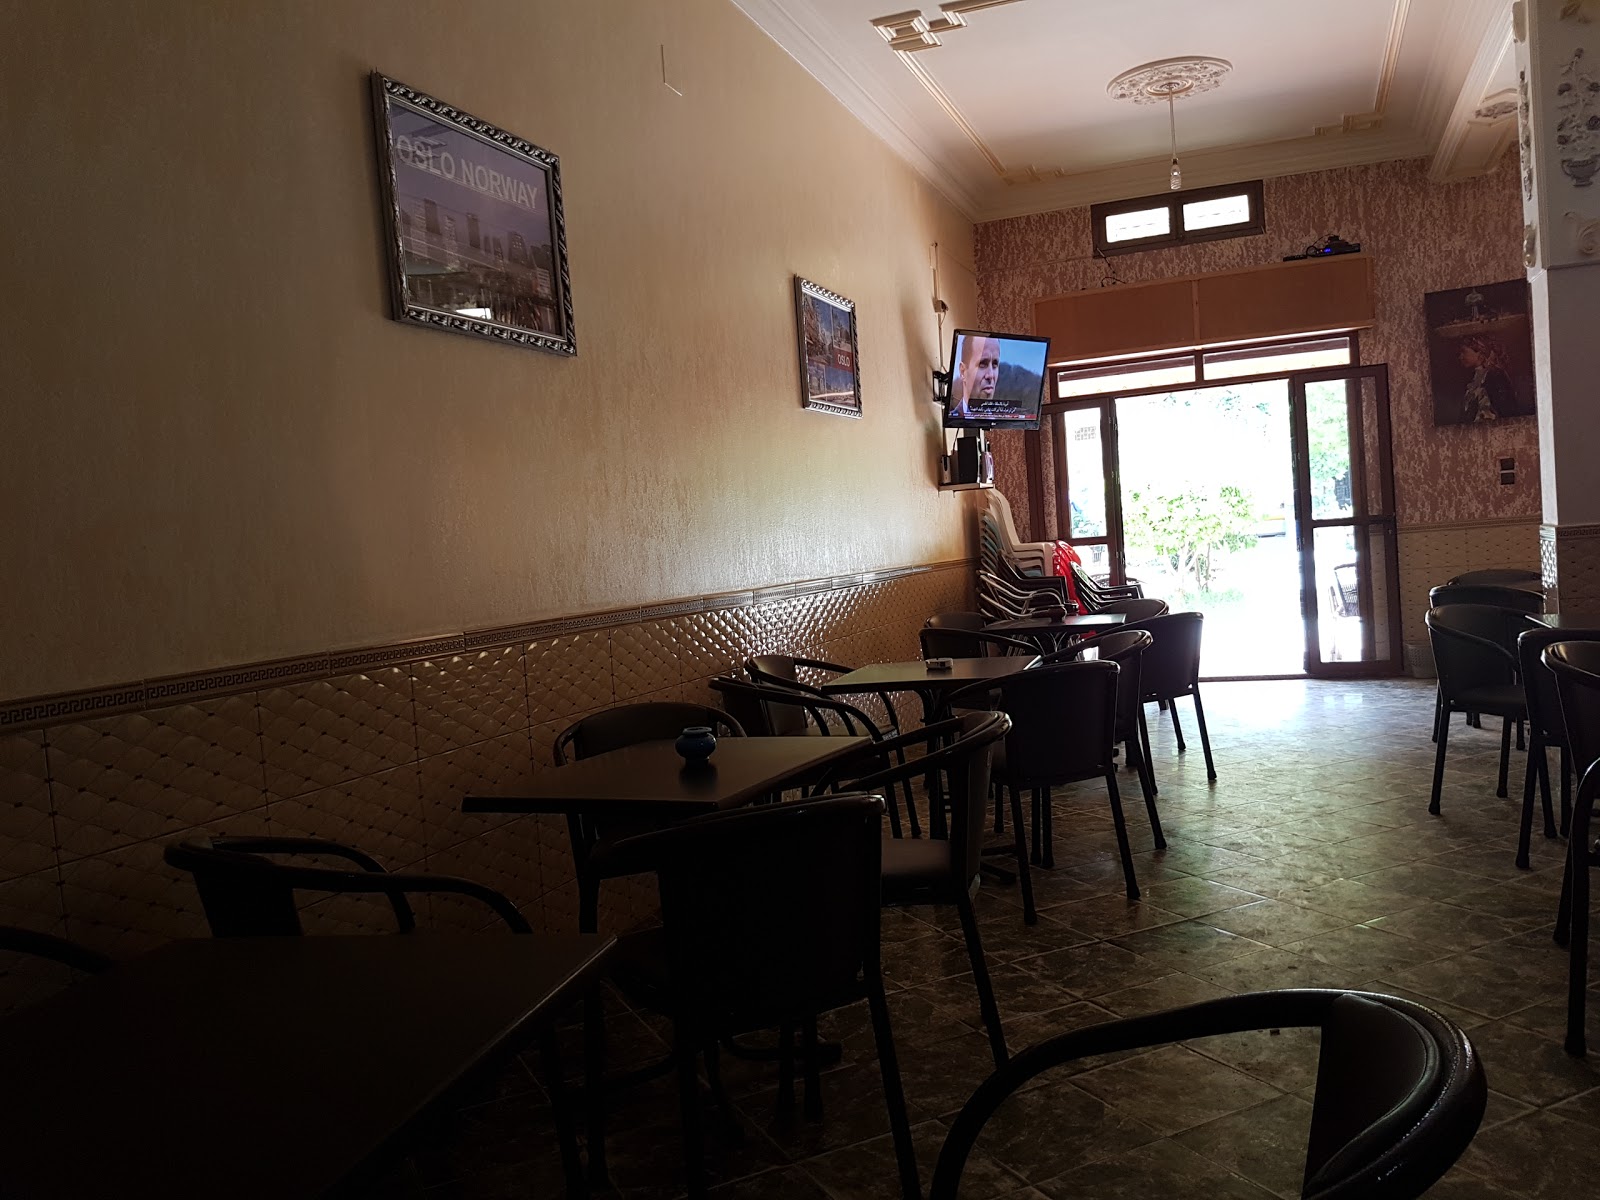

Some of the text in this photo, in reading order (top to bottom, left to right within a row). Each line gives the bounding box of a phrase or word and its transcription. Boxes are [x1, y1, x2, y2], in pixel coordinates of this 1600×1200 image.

[396, 135, 538, 209] OSLO NORWAY
[837, 354, 850, 367] OSLO
